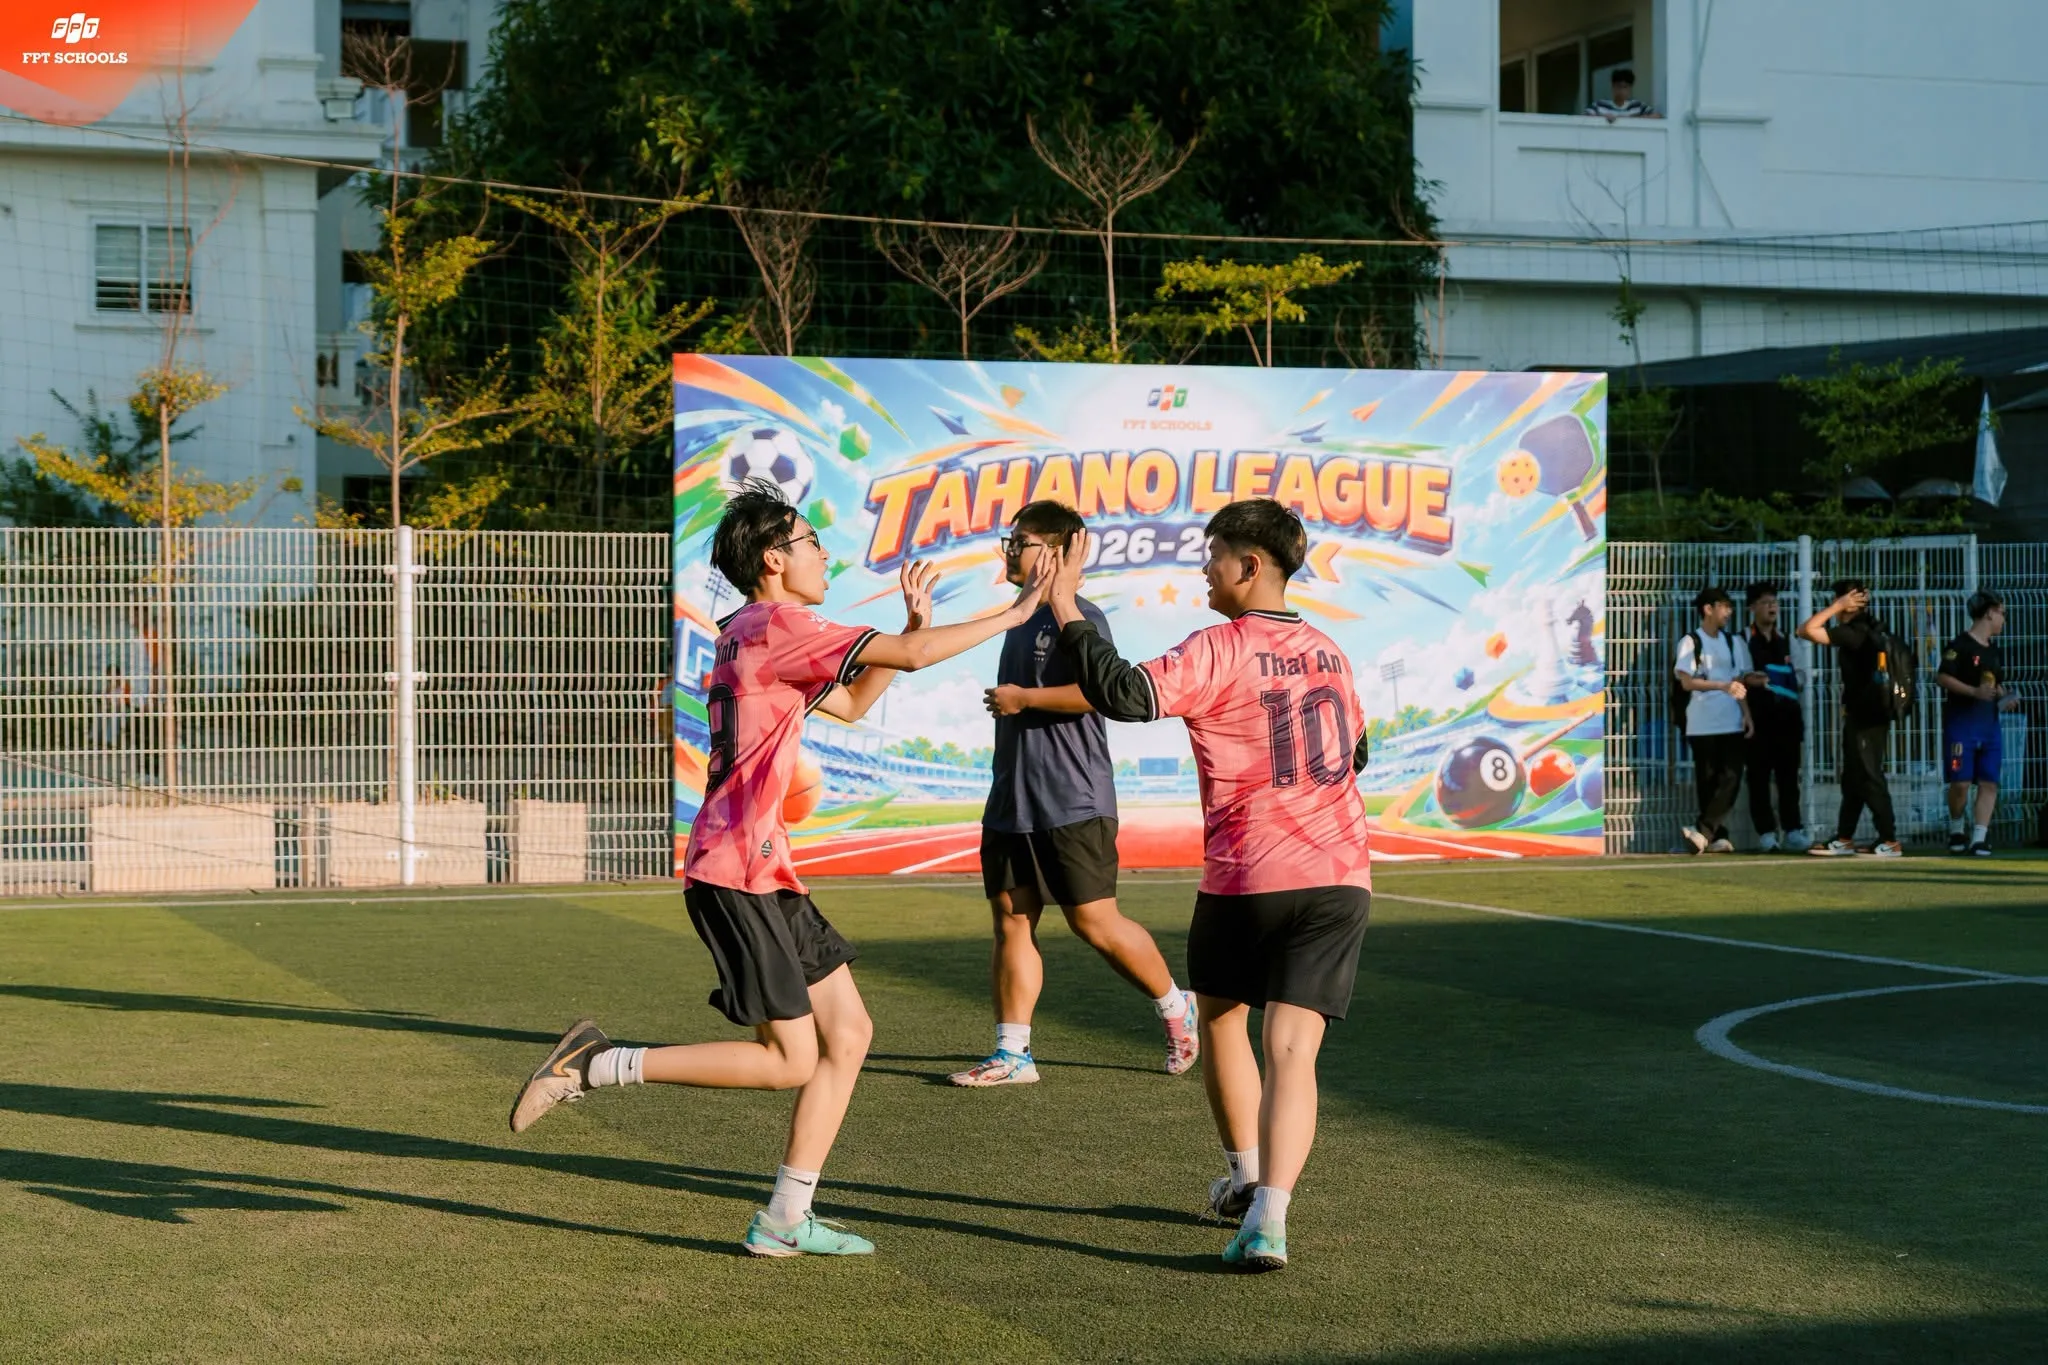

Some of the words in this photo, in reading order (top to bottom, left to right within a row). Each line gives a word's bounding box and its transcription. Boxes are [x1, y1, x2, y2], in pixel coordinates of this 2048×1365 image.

[867, 448, 1179, 566] TAHANO
[1190, 449, 1453, 546] LEAGUE
[1316, 649, 1342, 674] An
[1260, 685, 1354, 789] 10
[1492, 756, 1508, 782] 8
